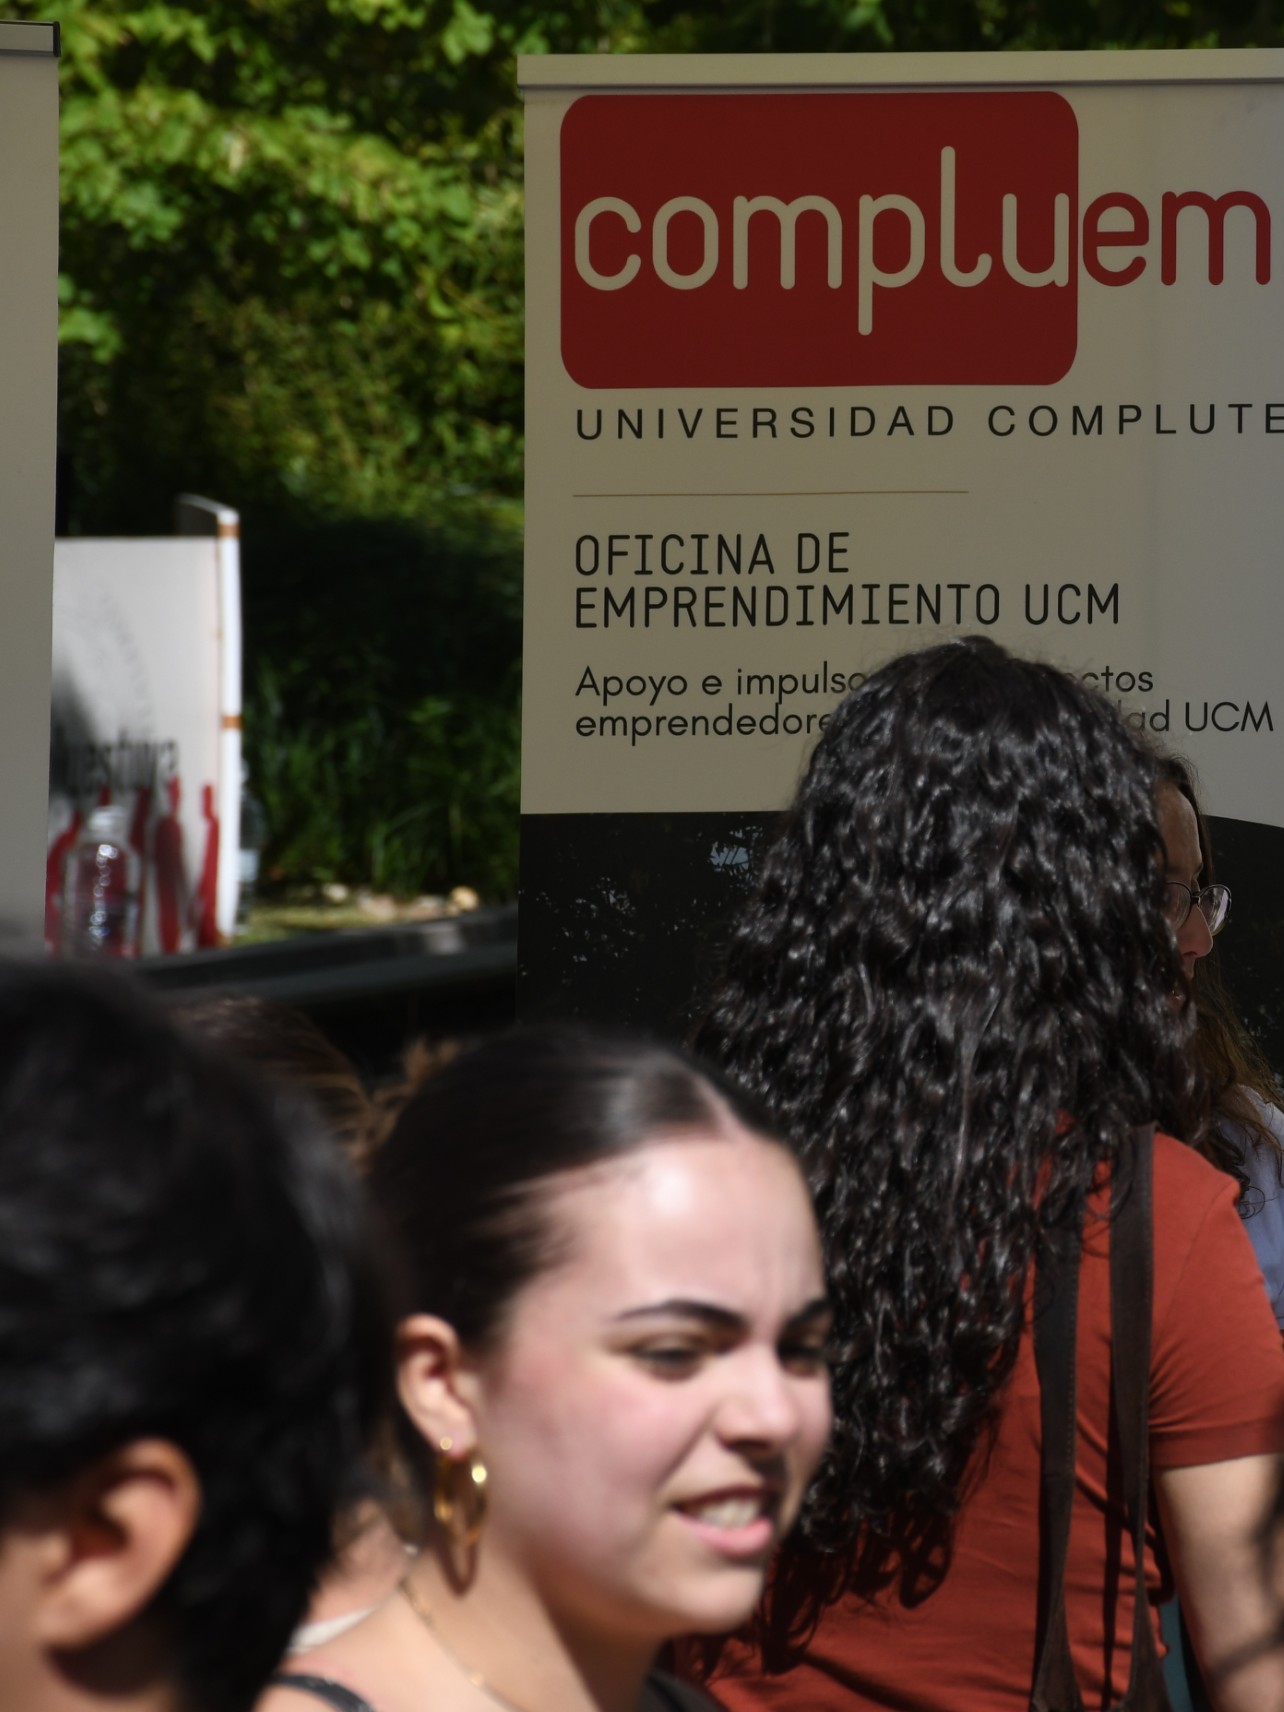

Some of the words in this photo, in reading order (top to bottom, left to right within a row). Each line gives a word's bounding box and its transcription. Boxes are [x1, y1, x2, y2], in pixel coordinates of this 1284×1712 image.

[575, 404, 955, 441] UNIVERSIDAD
[574, 533, 776, 577] OFICINA
[797, 531, 851, 575] DE
[575, 583, 1001, 629] EMPRENDIMIENTO
[1024, 582, 1120, 626] UCM
[574, 665, 689, 706] Apoyo
[701, 674, 724, 697] e
[1184, 699, 1275, 733] UCM
